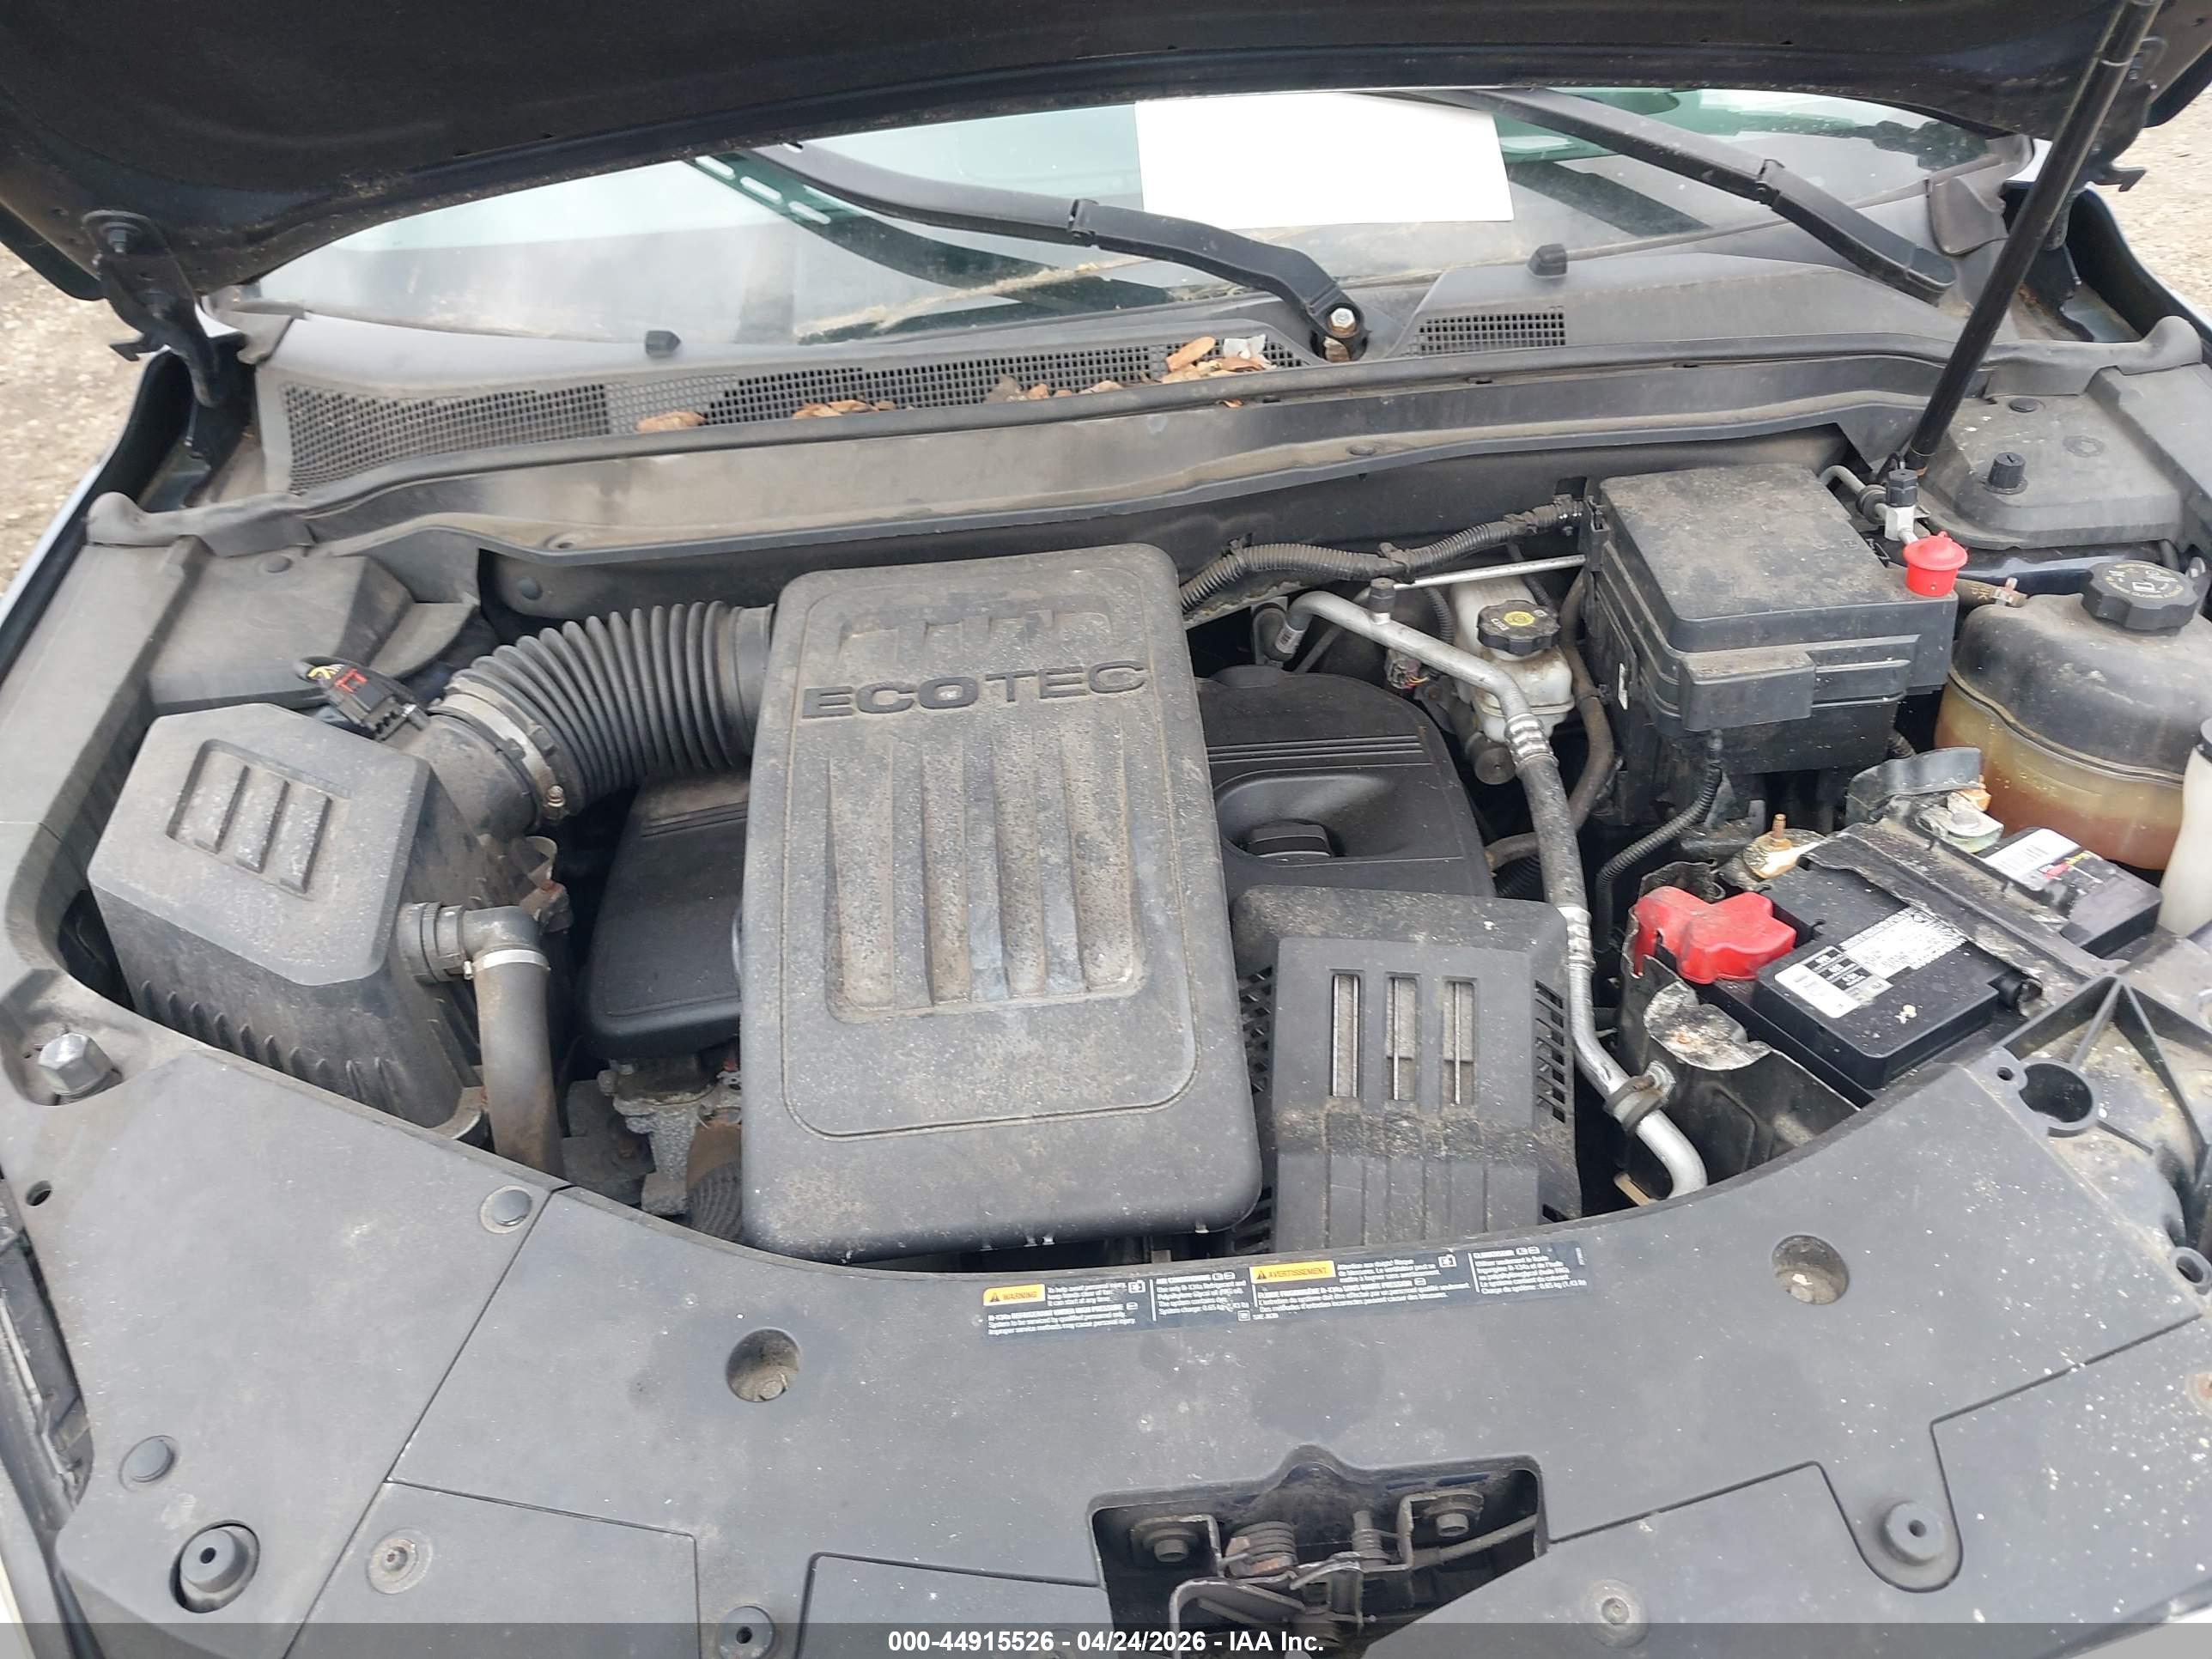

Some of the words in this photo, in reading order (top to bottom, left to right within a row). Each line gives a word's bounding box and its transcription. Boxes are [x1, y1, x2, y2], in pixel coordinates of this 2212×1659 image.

[802, 660, 1146, 720] ECOTEC
[1269, 1267, 1327, 1279] AVERTISSEMENT
[1003, 1292, 1036, 1301] WARNING
